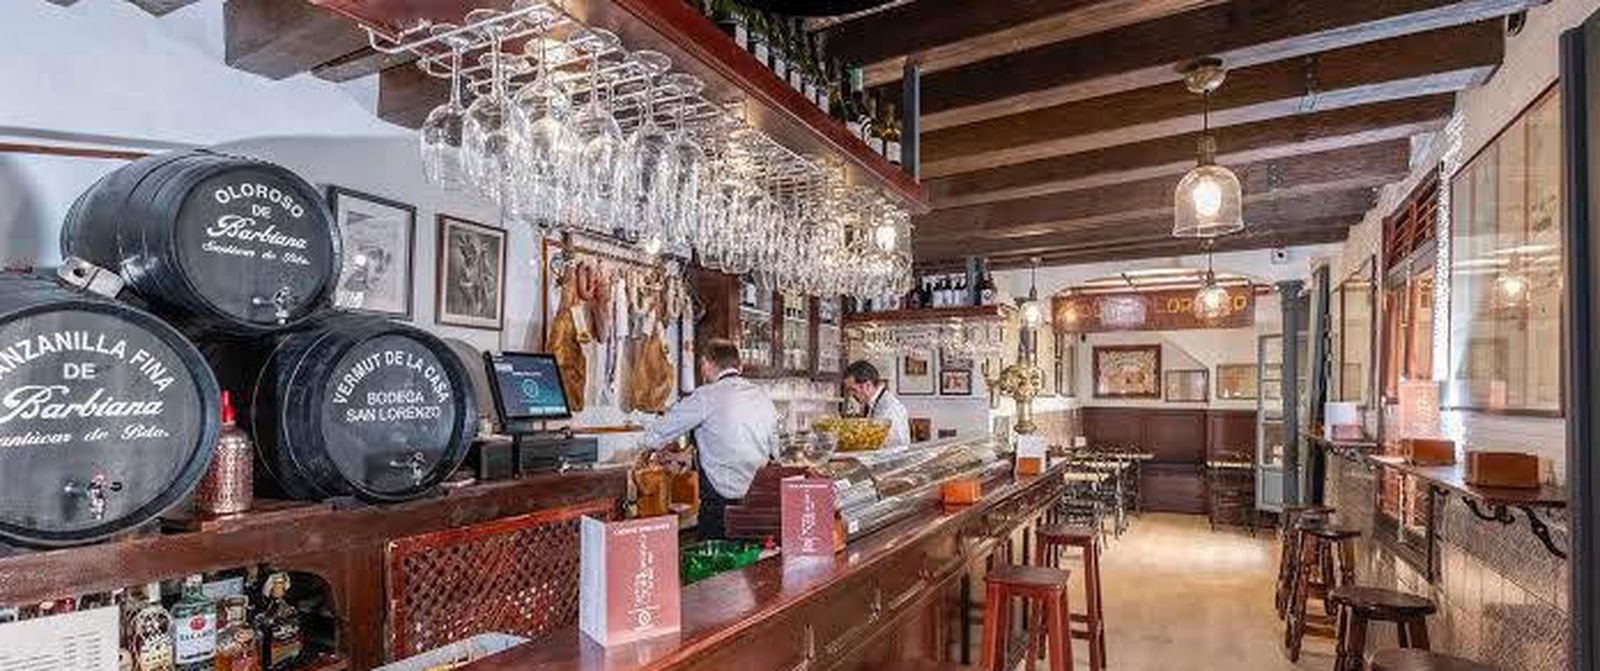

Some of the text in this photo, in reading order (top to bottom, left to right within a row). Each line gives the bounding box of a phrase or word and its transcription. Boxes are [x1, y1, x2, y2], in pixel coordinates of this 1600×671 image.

[215, 183, 304, 218] OLOROSO
[252, 204, 272, 219] DE
[207, 214, 308, 249] Barbiana
[0, 331, 175, 392] ANZANILLA FINA
[62, 362, 97, 380] DE
[332, 350, 450, 404] VERMUT DE LA CASA
[0, 385, 165, 424] Barbiana
[345, 405, 441, 423] SAN LORENZO
[366, 389, 425, 406] BODEGA
